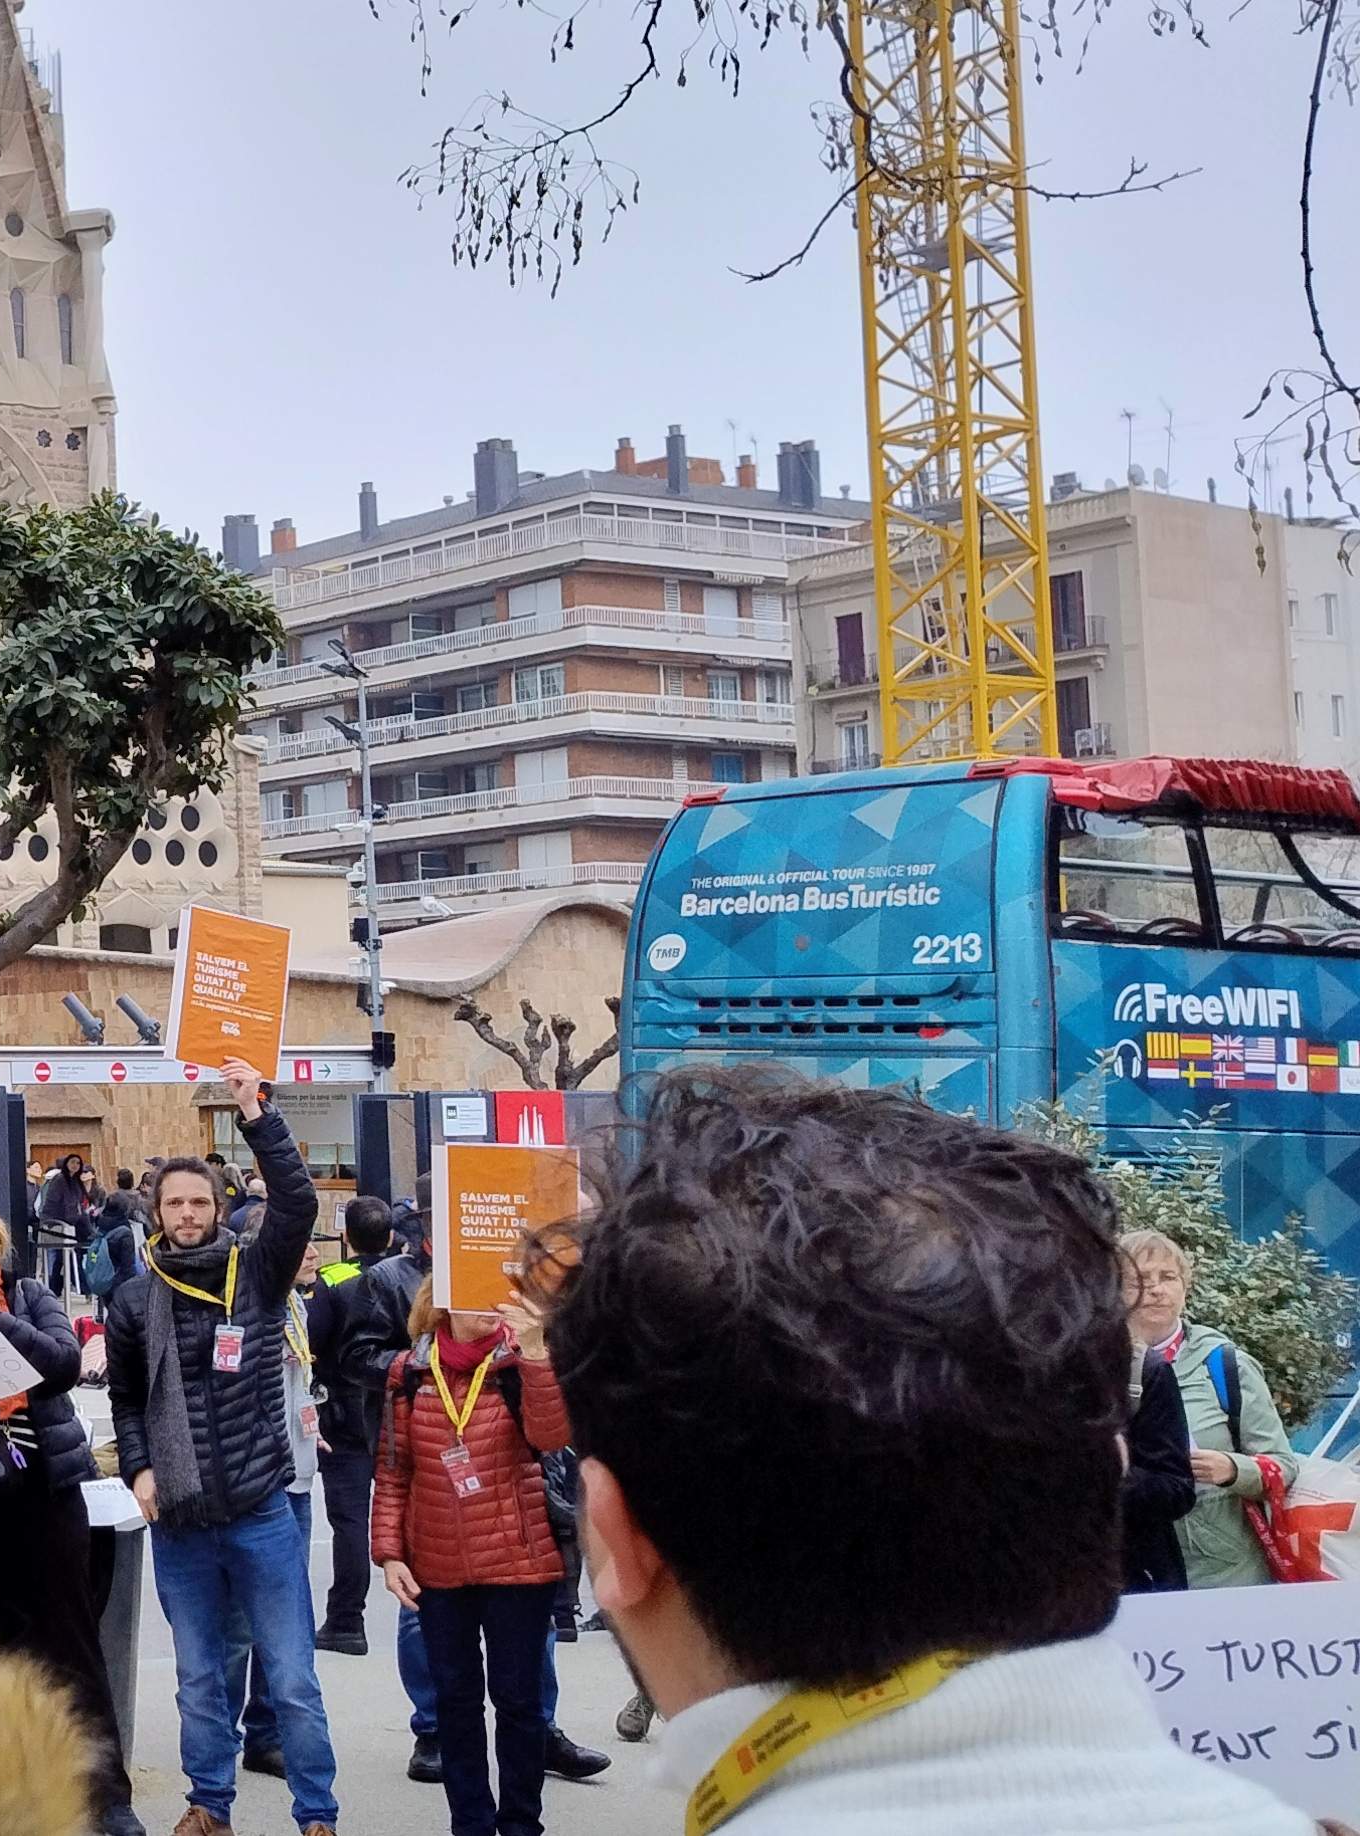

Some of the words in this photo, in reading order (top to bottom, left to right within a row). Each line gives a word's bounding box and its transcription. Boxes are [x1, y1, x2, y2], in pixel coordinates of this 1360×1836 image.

[691, 877, 712, 889] THE
[713, 874, 765, 888] ORIGINAL
[767, 875, 775, 885] &
[776, 870, 829, 884] OFFICIAL
[831, 868, 865, 881] TOUR
[867, 865, 904, 879] SINCE
[906, 863, 936, 877] 1987
[680, 889, 799, 918] Barcelona
[655, 947, 681, 959] TMB
[911, 932, 982, 965] 2213
[1144, 982, 1301, 1029] FreeWIFI
[459, 1191, 511, 1204] SALVEM
[513, 1193, 530, 1205] EL
[460, 1203, 517, 1216] TURISME
[460, 1216, 499, 1227] GUIAT
[503, 1216, 508, 1227] I
[460, 1226, 522, 1239] QUALITAT
[1132, 1649, 1186, 1692] US
